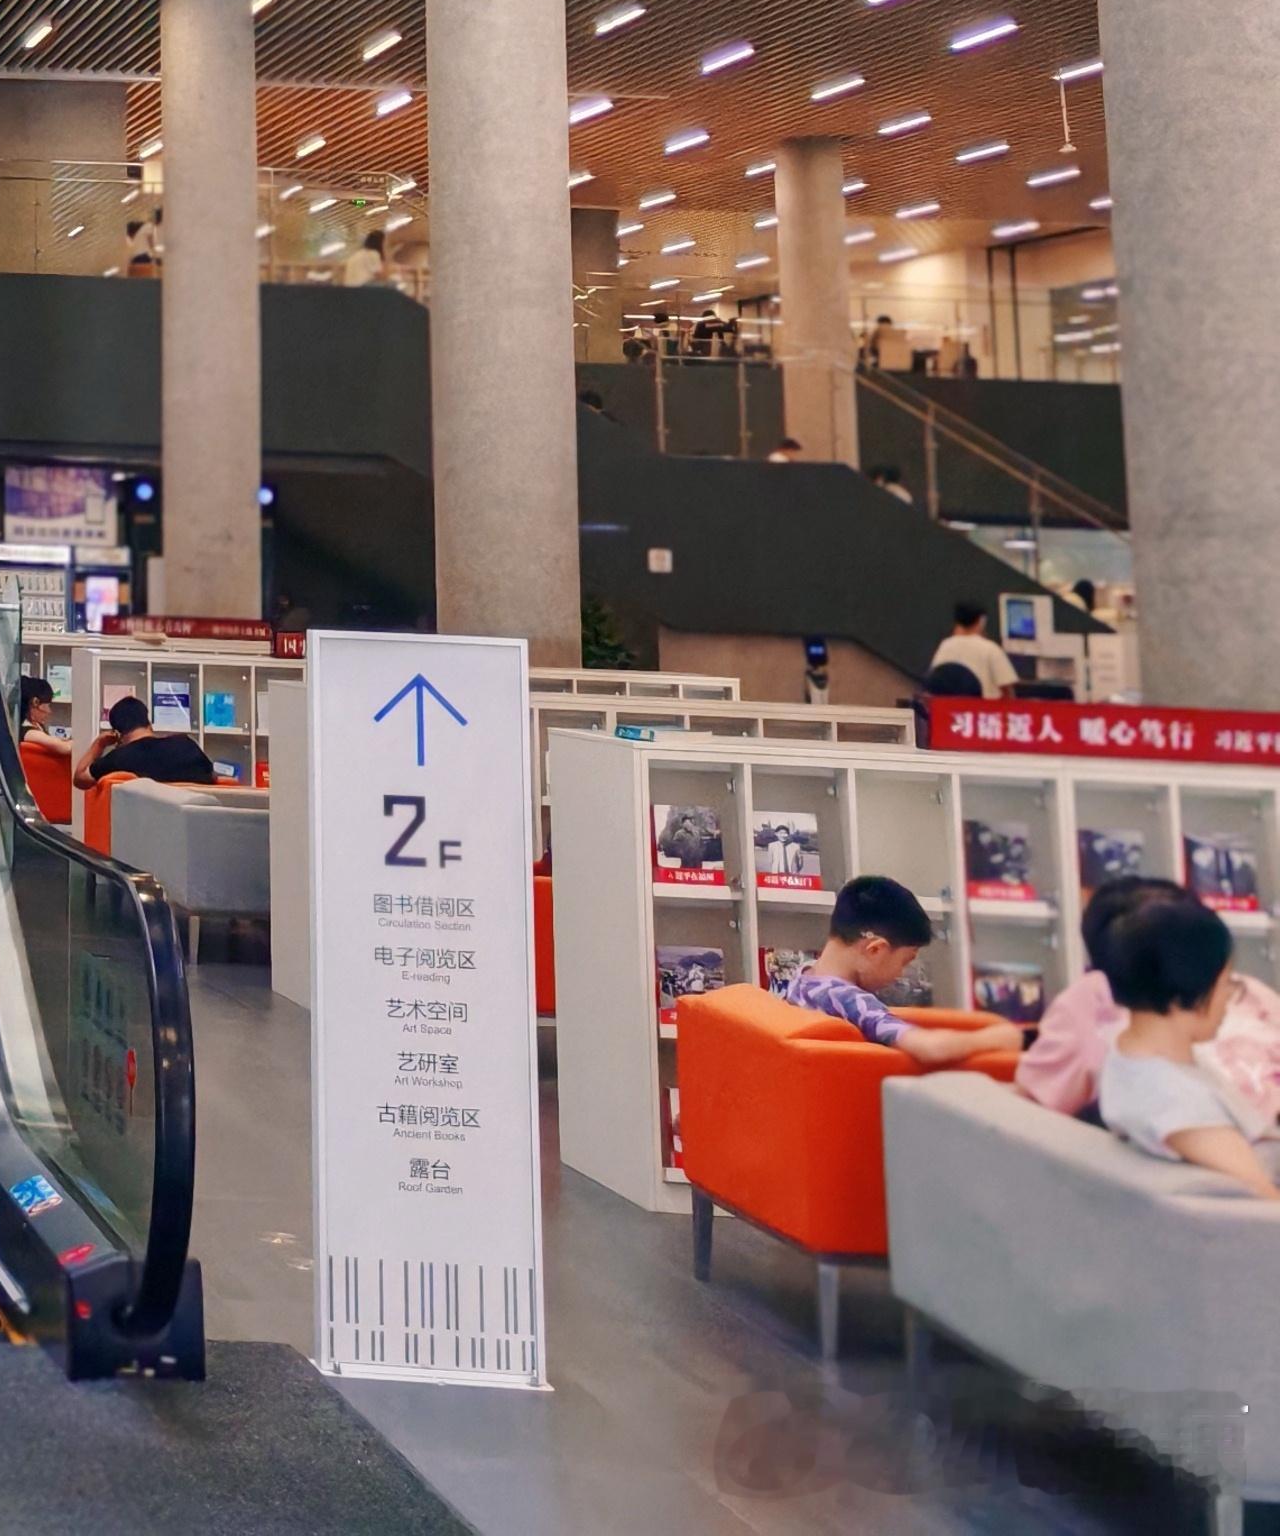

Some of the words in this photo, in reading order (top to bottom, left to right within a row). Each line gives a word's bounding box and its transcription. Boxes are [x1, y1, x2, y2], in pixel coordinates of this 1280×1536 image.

[950, 711, 1063, 743] 习语近人
[1079, 718, 1194, 750] 暖心笃行
[1215, 729, 1280, 755] 习近平
[373, 893, 475, 918] 图书借阅区
[378, 918, 431, 930] Circulation
[435, 921, 471, 932] Section
[374, 945, 477, 970] 电子阅览区
[401, 971, 451, 985] E-reading
[386, 998, 468, 1023] 艺术空间
[402, 1023, 417, 1034] Art
[420, 1024, 452, 1036] Space
[396, 1051, 459, 1075] 艺研室
[394, 1075, 409, 1086] Art
[412, 1076, 463, 1090] Workshop
[376, 1102, 481, 1128] 古籍阅览区
[393, 1128, 432, 1141] Ancient
[434, 1131, 466, 1142] Books
[409, 1158, 451, 1181] 露台
[398, 1181, 422, 1192] Roof
[425, 1183, 463, 1195] Garden
